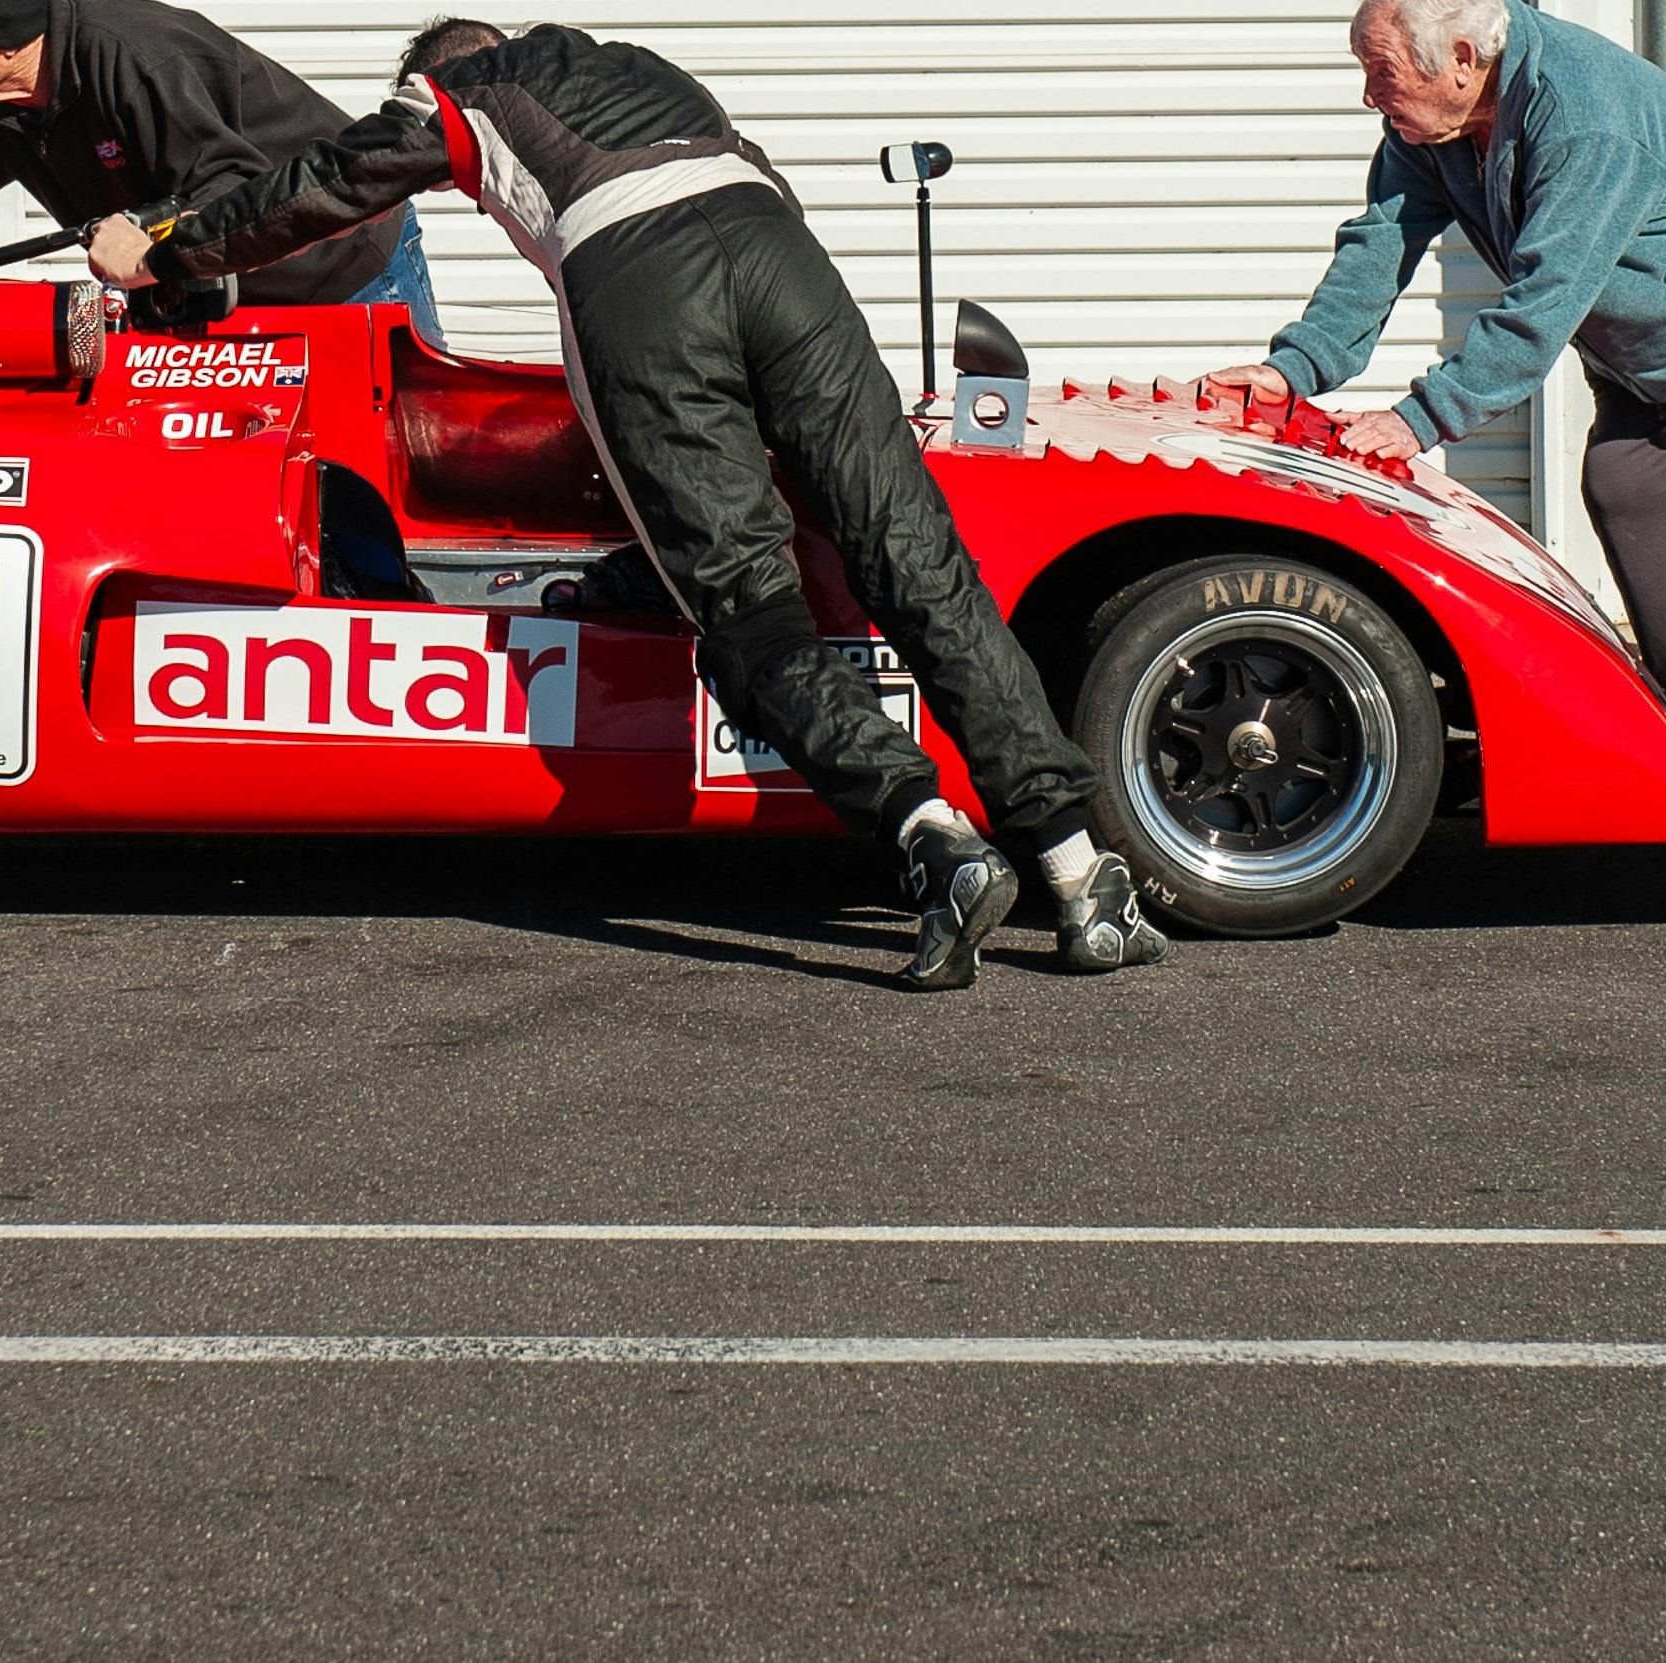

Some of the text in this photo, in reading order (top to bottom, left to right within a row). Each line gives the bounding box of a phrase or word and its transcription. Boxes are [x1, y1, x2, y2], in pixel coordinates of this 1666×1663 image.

[125, 342, 282, 369] MICHAEL
[130, 366, 269, 388] GIBSON
[161, 410, 234, 440] OIL
[1202, 569, 1348, 625] AVON
[147, 616, 568, 736] antar
